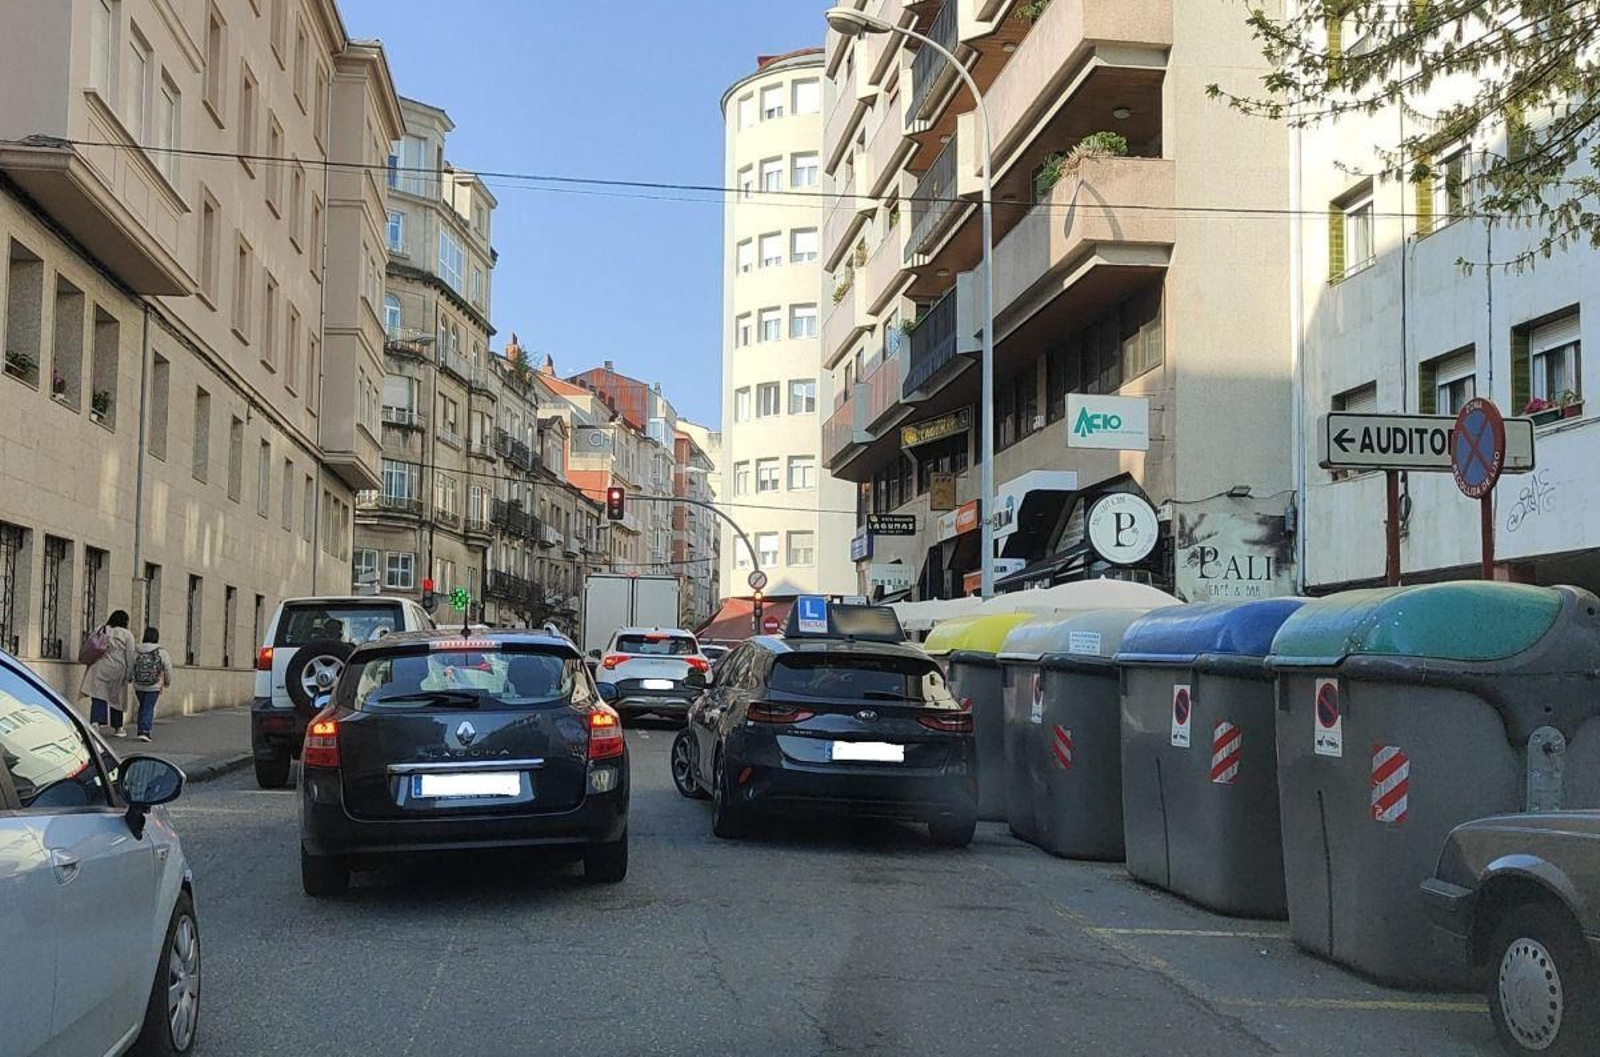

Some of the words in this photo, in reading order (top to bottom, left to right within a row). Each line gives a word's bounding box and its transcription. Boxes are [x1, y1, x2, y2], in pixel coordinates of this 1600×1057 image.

[1359, 426, 1453, 455] AUDITO
[805, 600, 820, 618] L
[430, 749, 510, 758] LAGUNA
